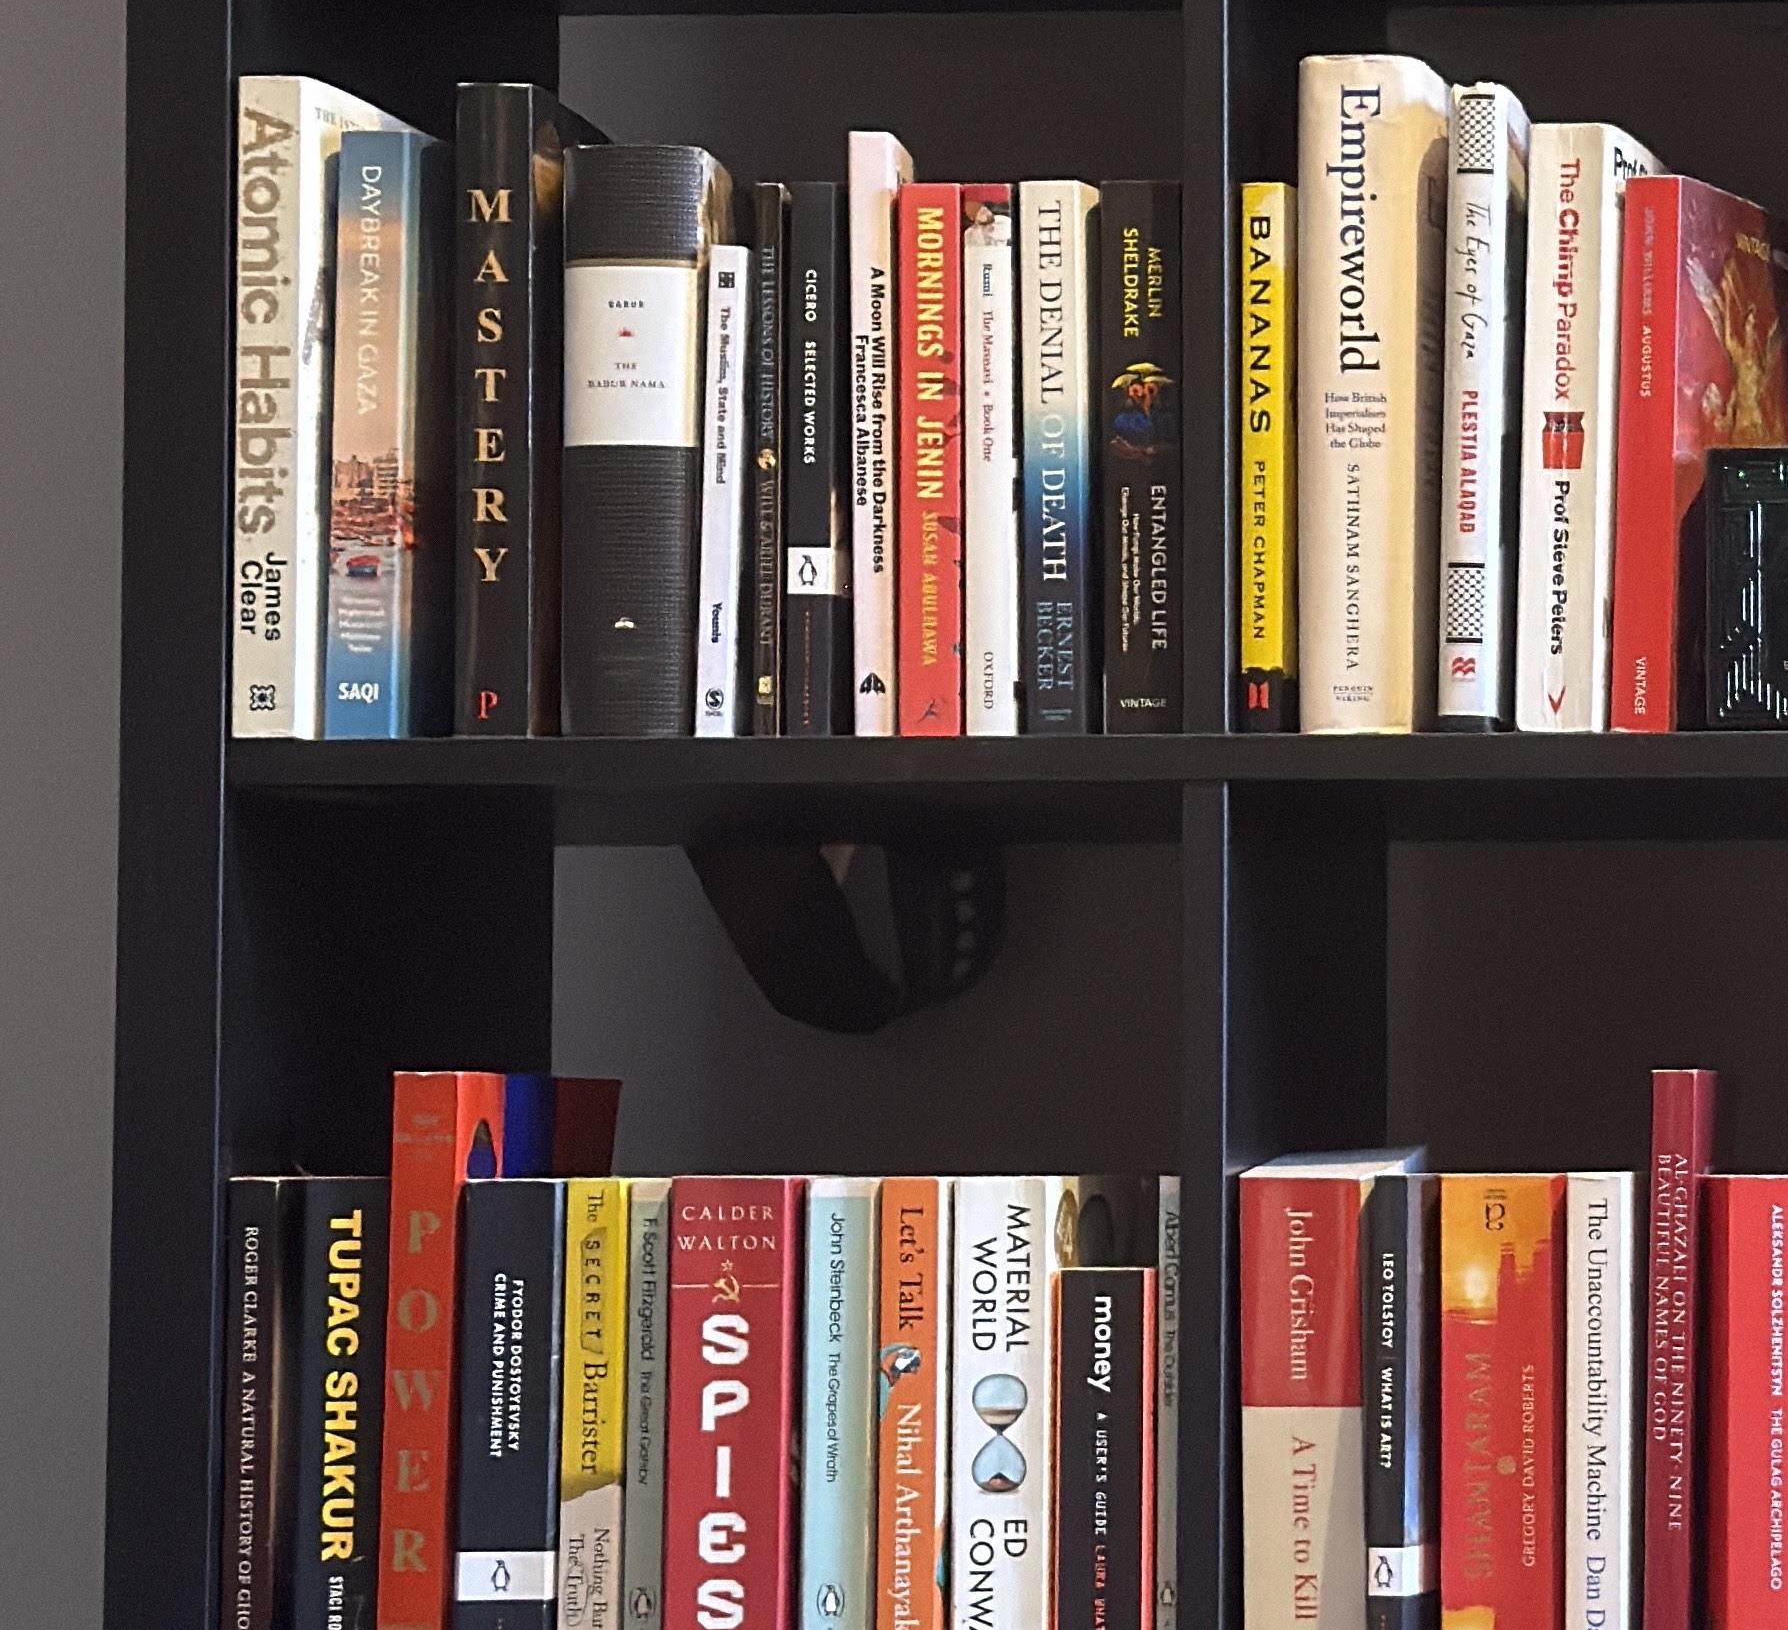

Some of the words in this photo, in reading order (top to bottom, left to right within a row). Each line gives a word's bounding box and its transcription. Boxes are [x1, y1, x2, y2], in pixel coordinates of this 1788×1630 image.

[239, 107, 297, 325] Atomic
[360, 165, 382, 303] DAYBREAK
[1326, 84, 1381, 373] Empireworld
[917, 206, 944, 358] MORNINGS
[359, 311, 378, 336] IN
[1250, 216, 1270, 434] BANANAS
[357, 344, 378, 415] GAZA
[466, 189, 511, 583] MASTERY
[854, 334, 868, 420] Francesca
[918, 370, 942, 400] IN
[237, 346, 292, 535] Habits
[917, 414, 943, 499] JENIN
[1460, 391, 1478, 461] PLESTIA
[855, 425, 868, 506] Albanese
[1253, 460, 1266, 527] PETER
[1459, 468, 1476, 533] ALAQAD
[1150, 486, 1167, 603] ENTANGLED
[1346, 464, 1360, 559] SATHNAM
[239, 561, 262, 634] Clear
[266, 550, 289, 641] James
[1251, 536, 1266, 640] CHAPMAN
[1346, 566, 1359, 669] SANGHERA
[1151, 610, 1167, 650] LIFE
[338, 682, 379, 700] SAQI
[1634, 657, 1646, 716] VINTAGE
[677, 1236, 776, 1251] WALTON
[682, 1205, 773, 1222] CALDER
[901, 1207, 924, 1265] Let's
[1287, 1207, 1313, 1269] John
[1587, 1199, 1609, 1241] The
[327, 1210, 361, 1356] TUPAC
[495, 1274, 506, 1317] CRIME
[899, 1272, 923, 1330] Talk
[972, 1237, 996, 1351] WORLD
[1006, 1204, 1030, 1354] MATERIAL
[493, 1322, 504, 1351] AND
[1087, 1296, 1112, 1393] money
[1288, 1275, 1313, 1380] Grisham
[1584, 1249, 1613, 1436] Unaccountability
[392, 1211, 441, 1572] POWER
[490, 1358, 502, 1457] PUNISHMENT
[1380, 1368, 1393, 1411] WHAT
[1380, 1418, 1393, 1428] IS
[321, 1371, 357, 1562] SHAKUR
[697, 1314, 750, 1630] SPIES
[898, 1404, 922, 1472] Nihal
[1293, 1436, 1316, 1456] A
[1380, 1433, 1392, 1468] ART?
[1293, 1466, 1315, 1528] Time
[1587, 1445, 1613, 1540] Machine
[1004, 1519, 1028, 1558] ED
[1294, 1540, 1313, 1563] to
[1295, 1573, 1318, 1620] Kill
[1586, 1556, 1609, 1600] Dan
